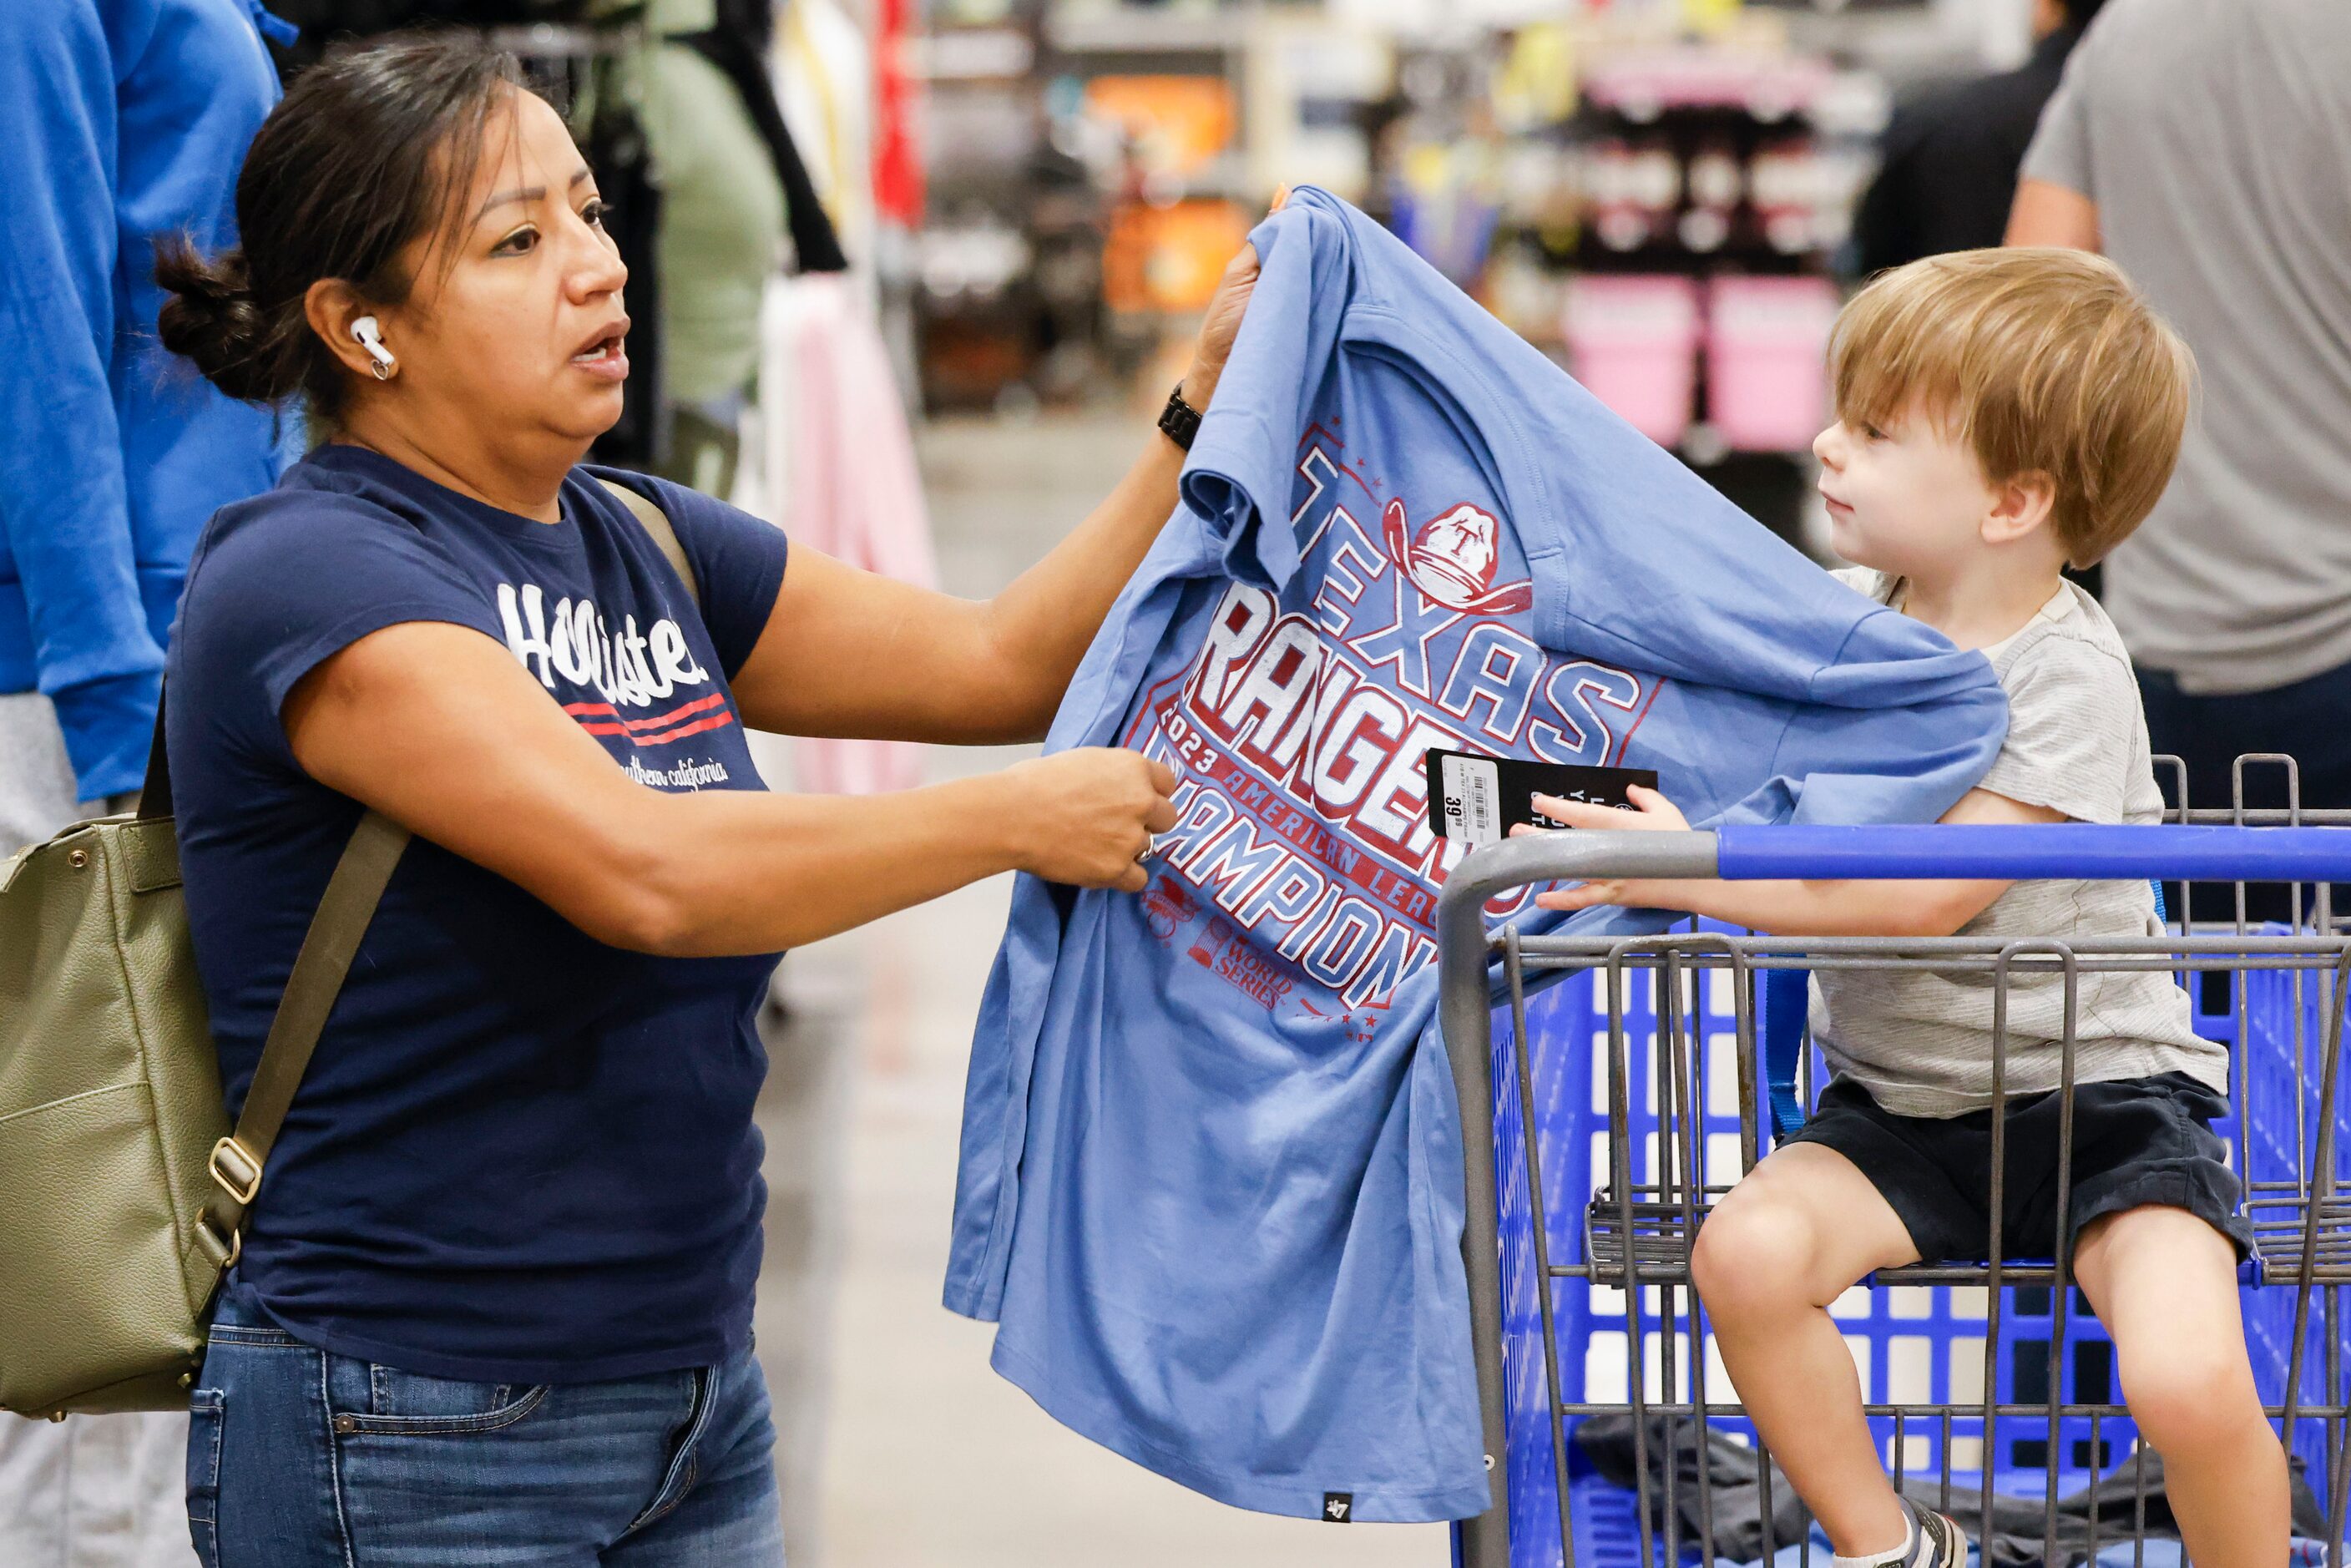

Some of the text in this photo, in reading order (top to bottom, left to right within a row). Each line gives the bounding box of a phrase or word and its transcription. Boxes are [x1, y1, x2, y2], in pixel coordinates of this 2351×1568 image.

[1450, 524, 1479, 557] T
[1290, 443, 1641, 766] TEXAS
[497, 583, 710, 707] Holliste
[668, 756, 728, 792] california
[1185, 578, 1534, 918] RANGE
[1160, 701, 1438, 926] 2023 AMERICAN LEA
[1445, 797, 1462, 817] 39
[1216, 957, 1280, 1009] SERIES
[1228, 942, 1292, 994] WORLD
